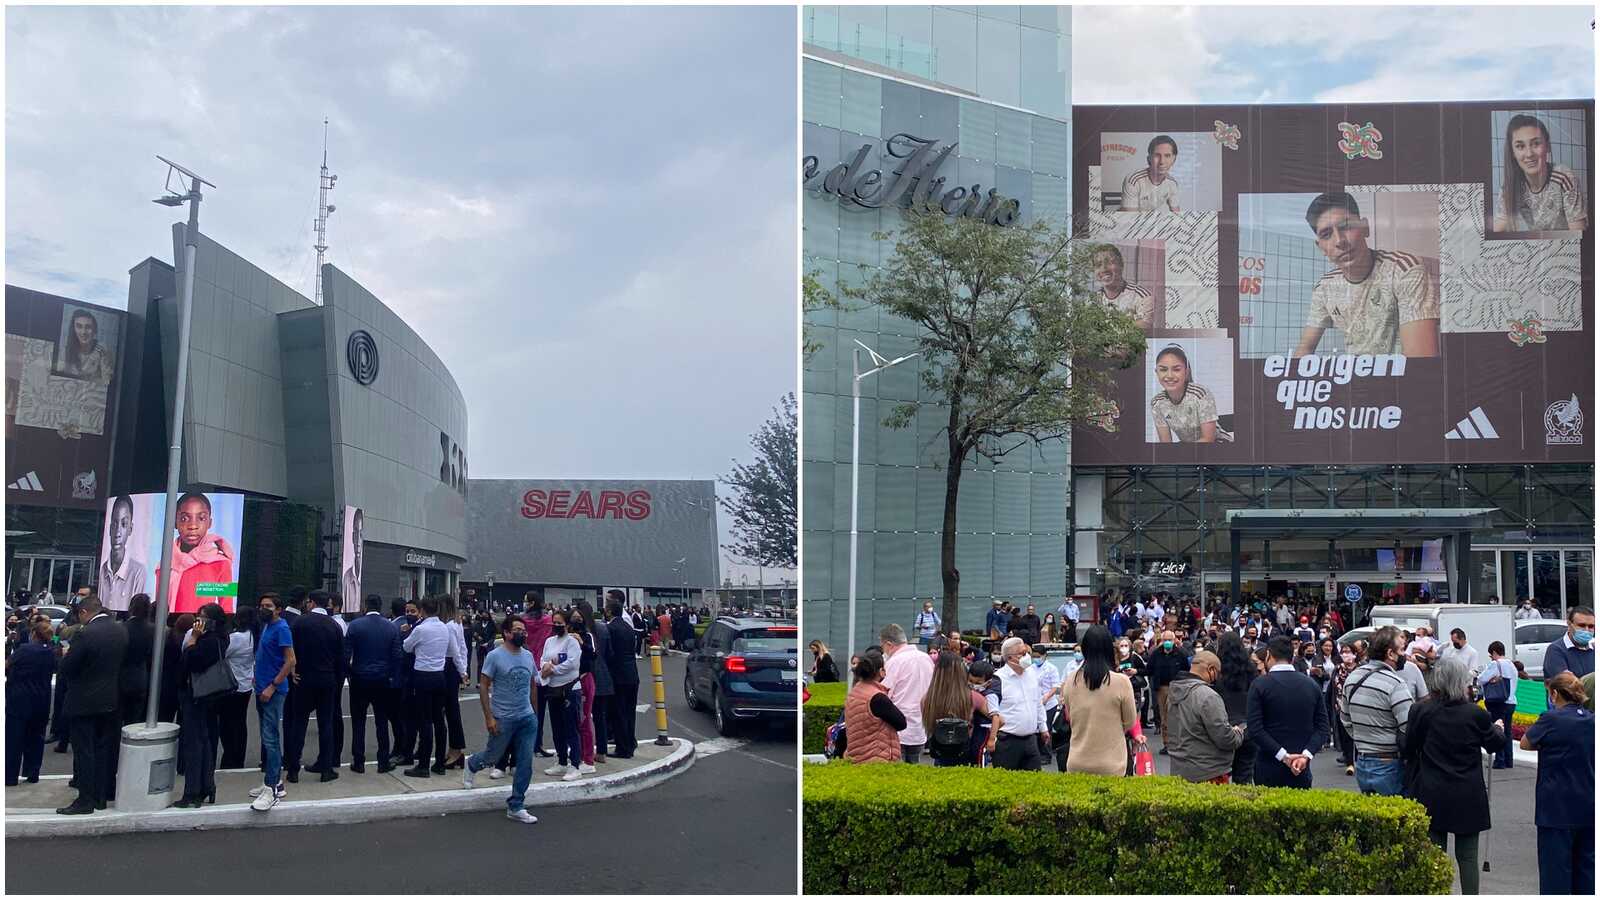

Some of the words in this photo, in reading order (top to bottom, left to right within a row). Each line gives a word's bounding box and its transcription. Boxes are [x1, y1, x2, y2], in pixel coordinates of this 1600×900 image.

[823, 144, 882, 201] de
[868, 133, 1020, 226] Hierro
[1264, 348, 1293, 377] el
[1298, 348, 1407, 384] origen
[1277, 380, 1332, 410] que
[1294, 406, 1346, 429] nos
[1349, 406, 1402, 429] une
[521, 489, 652, 520] SEARS
